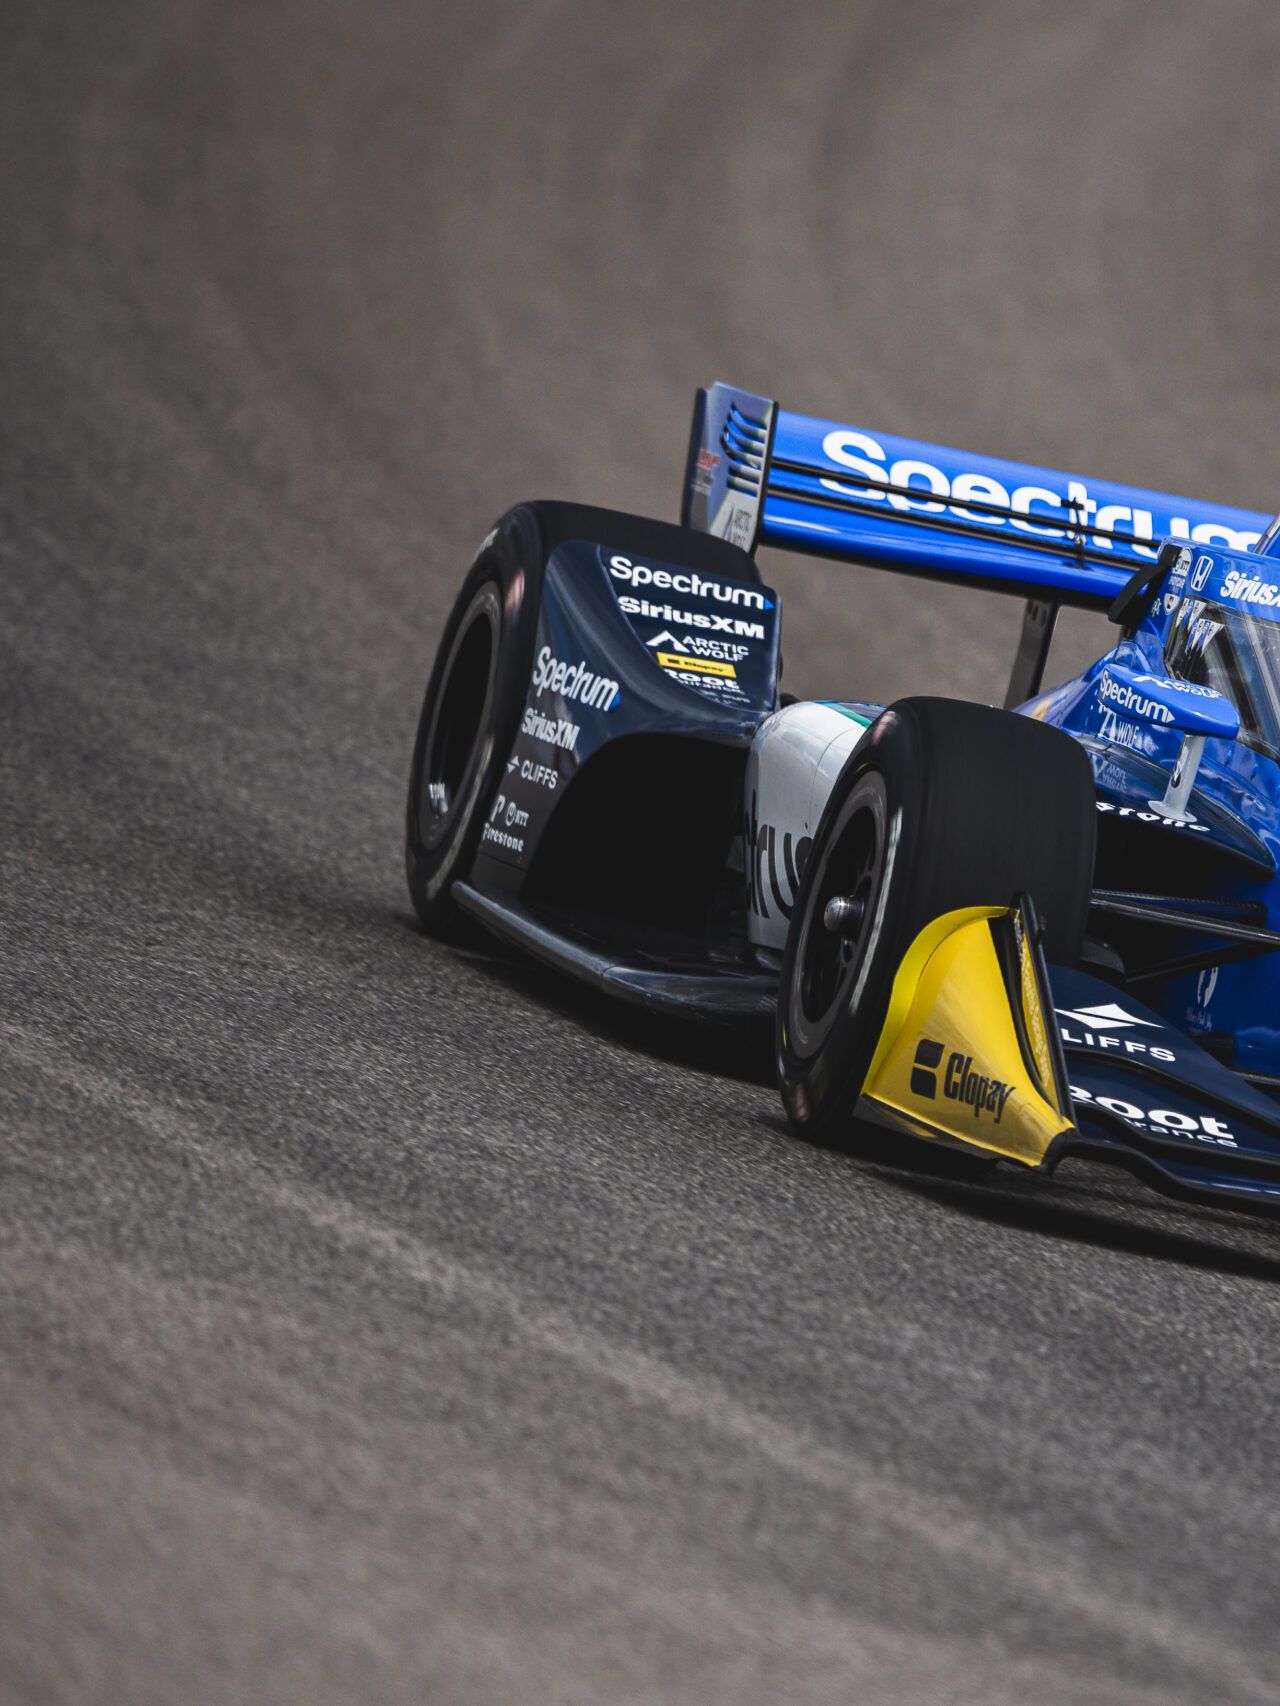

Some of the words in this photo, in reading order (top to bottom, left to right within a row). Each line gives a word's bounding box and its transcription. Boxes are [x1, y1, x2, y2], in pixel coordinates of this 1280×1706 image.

[609, 555, 764, 611] Spectrum
[617, 595, 765, 640] SiriusXM
[682, 635, 749, 656] ARCTIC
[692, 645, 744, 662] WOLF
[532, 646, 620, 712] Spectrum
[1100, 671, 1170, 723] Spectrum
[521, 707, 580, 751] SiriusXM
[1117, 720, 1141, 748] WOLF
[520, 759, 559, 790] CLIFFS
[482, 822, 524, 852] Firestone
[1060, 1027, 1177, 1063] LIFFS
[944, 1051, 1017, 1125] Clopay
